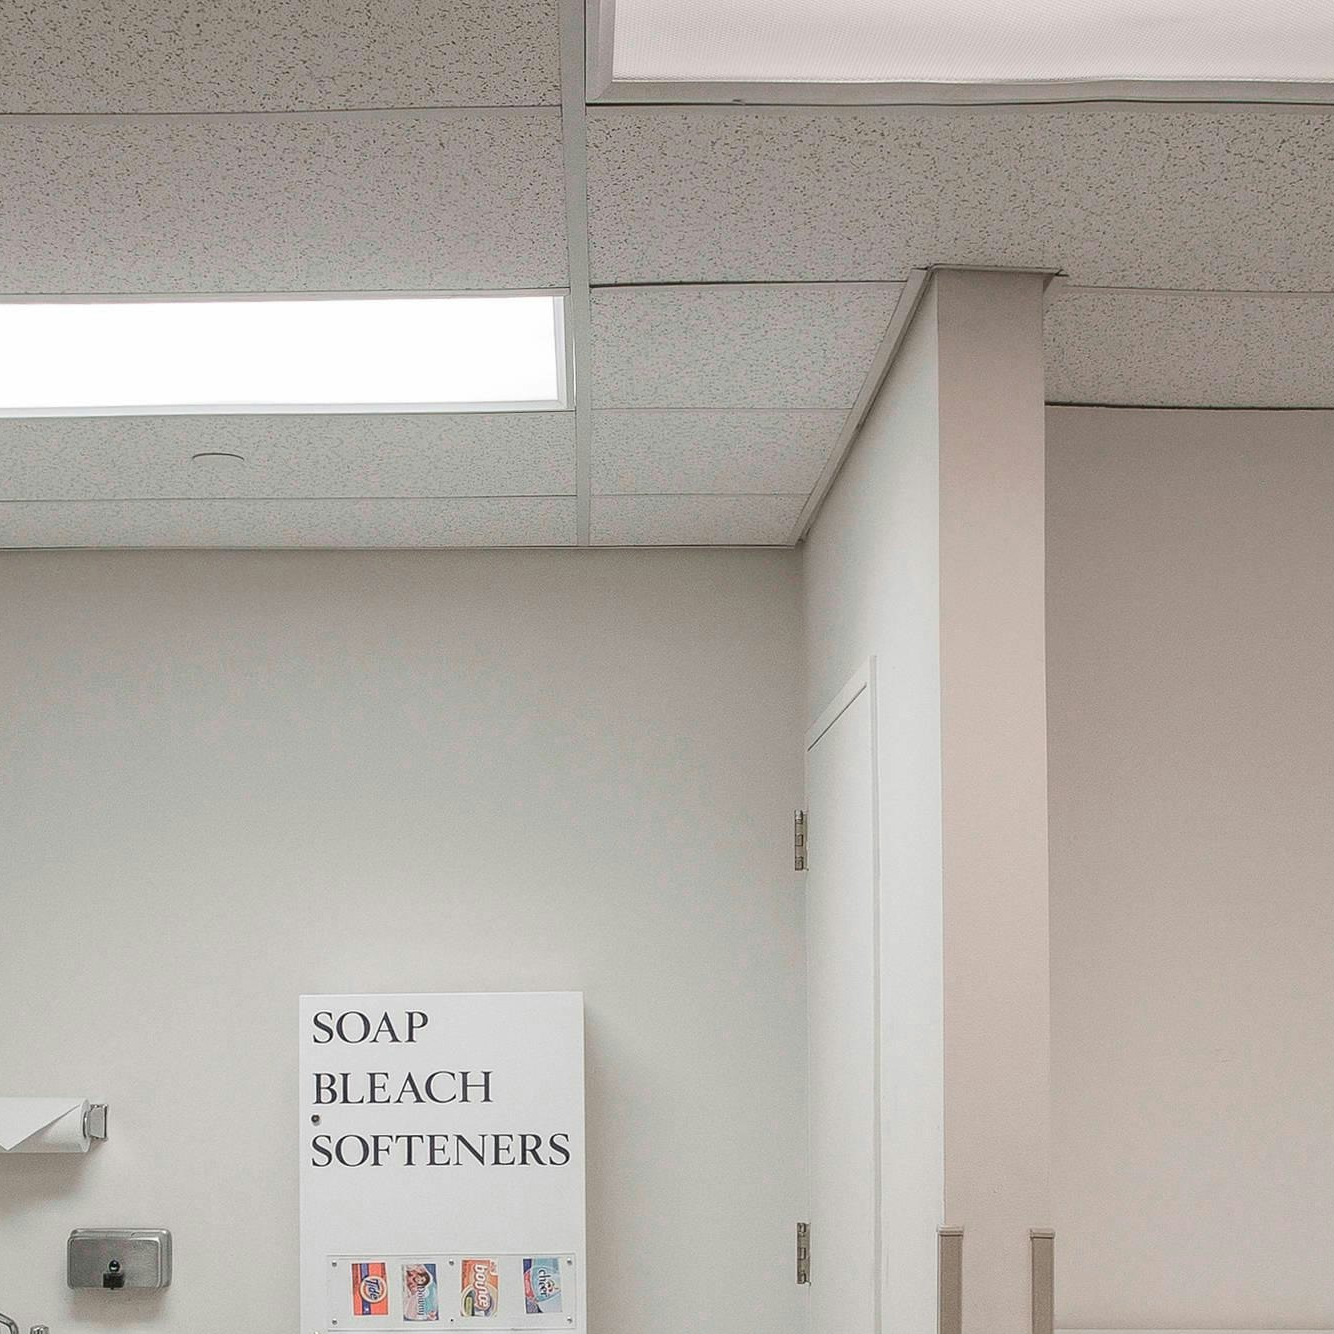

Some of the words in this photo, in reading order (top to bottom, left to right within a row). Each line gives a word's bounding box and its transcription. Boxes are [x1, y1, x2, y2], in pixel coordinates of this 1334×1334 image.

[312, 1011, 429, 1044] SOAP
[312, 1071, 494, 1105] BLEACH
[311, 1133, 571, 1167] SOFTENERS
[366, 1278, 381, 1300] Tide
[538, 1269, 551, 1298] cheer
